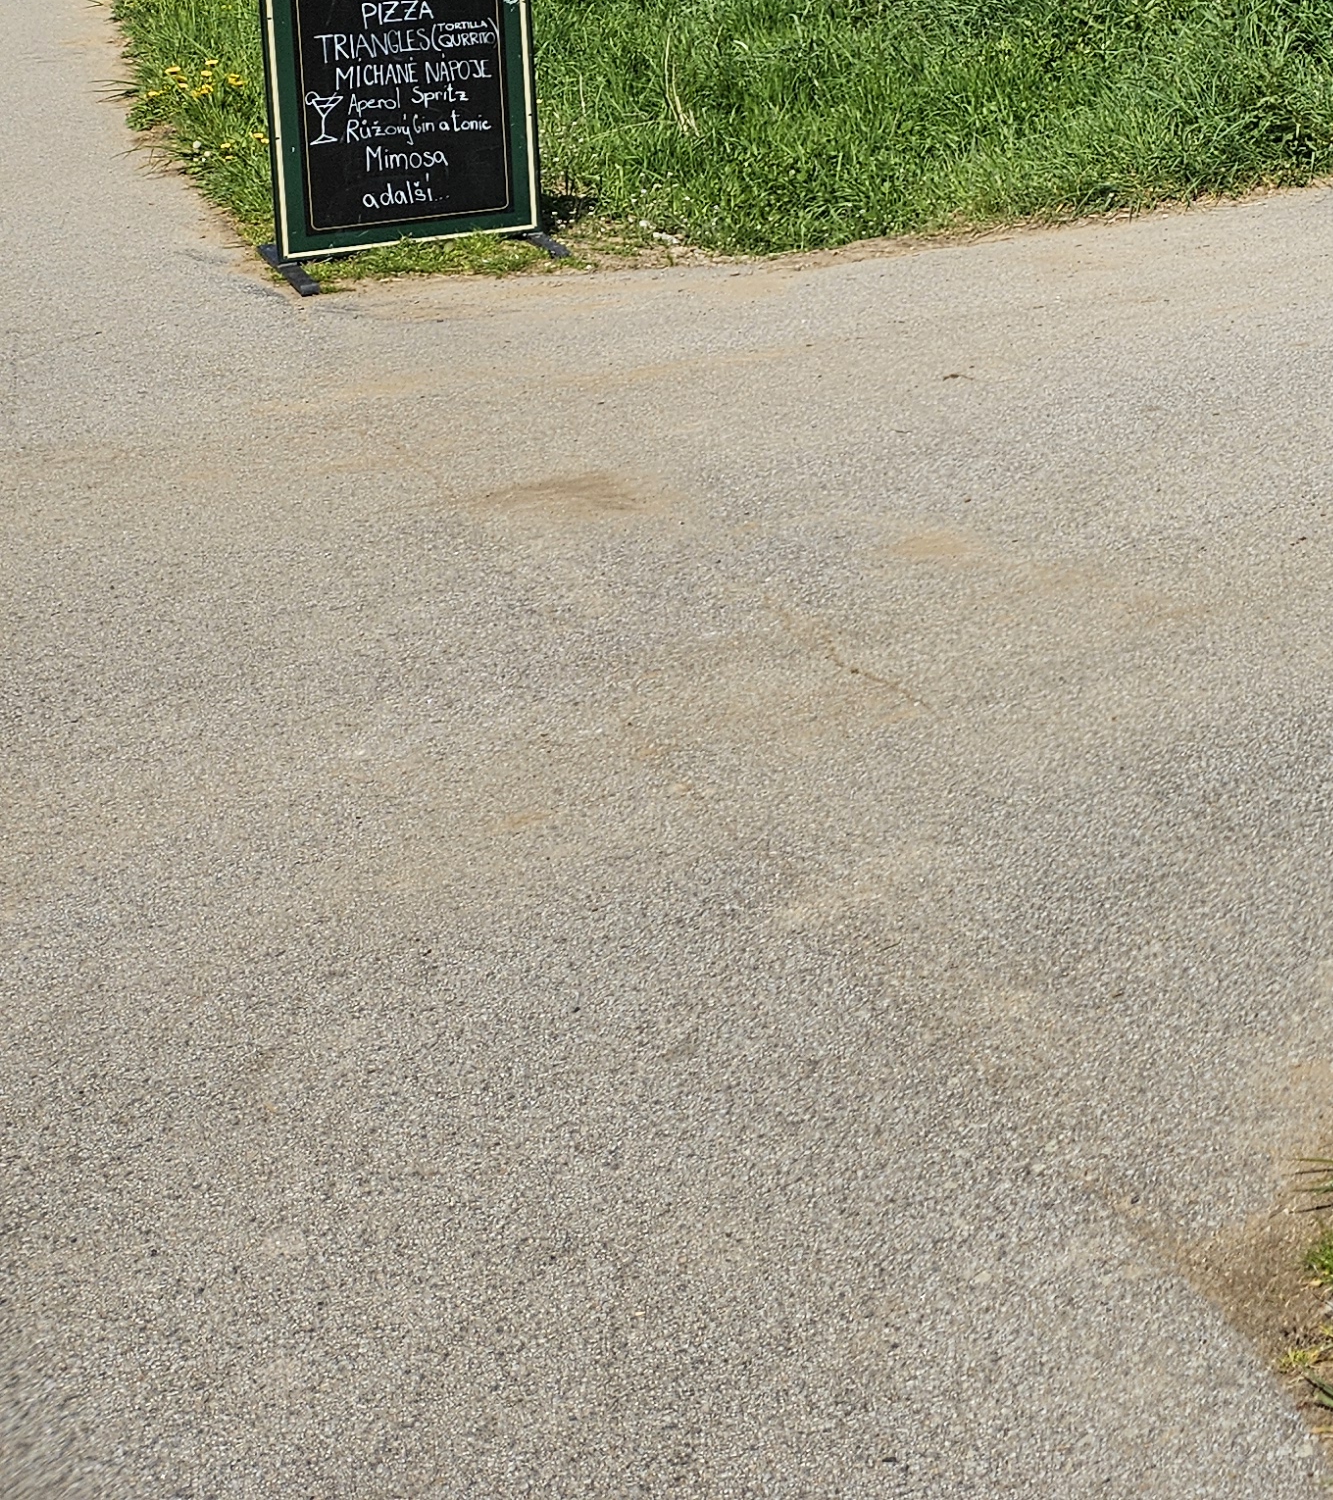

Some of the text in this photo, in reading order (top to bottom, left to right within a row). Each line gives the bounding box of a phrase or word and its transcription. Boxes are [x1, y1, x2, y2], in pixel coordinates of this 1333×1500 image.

[361, 0, 435, 30] PIZZA
[313, 28, 431, 64] TRIANGLES
[424, 52, 492, 84] NÁPOJE
[347, 83, 470, 118] Aperol Spritz
[365, 145, 449, 172] Mimosa
